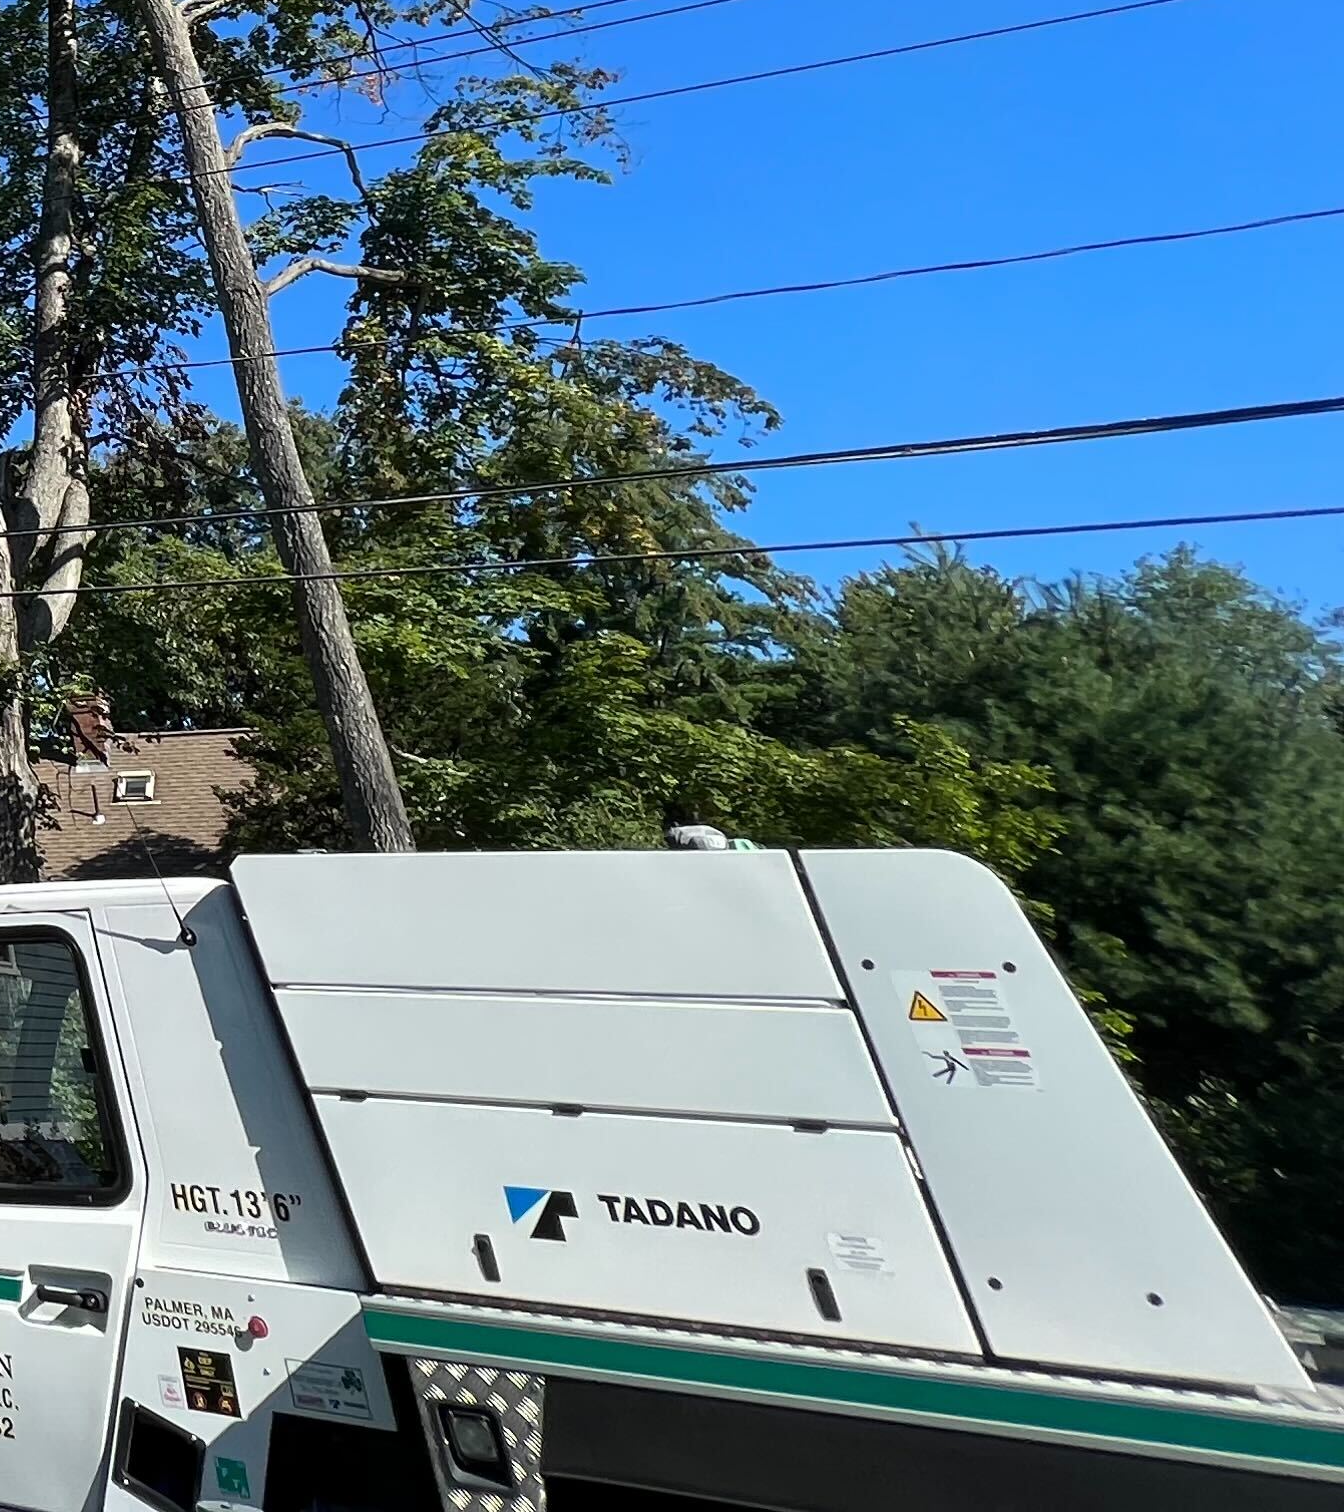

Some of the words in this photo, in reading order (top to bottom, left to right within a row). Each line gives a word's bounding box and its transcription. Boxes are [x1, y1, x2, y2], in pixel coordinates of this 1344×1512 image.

[597, 1193, 761, 1237] TADANO
[141, 1312, 190, 1331] USDOT
[144, 1296, 208, 1320] PALMER,
[211, 1305, 235, 1322] MA
